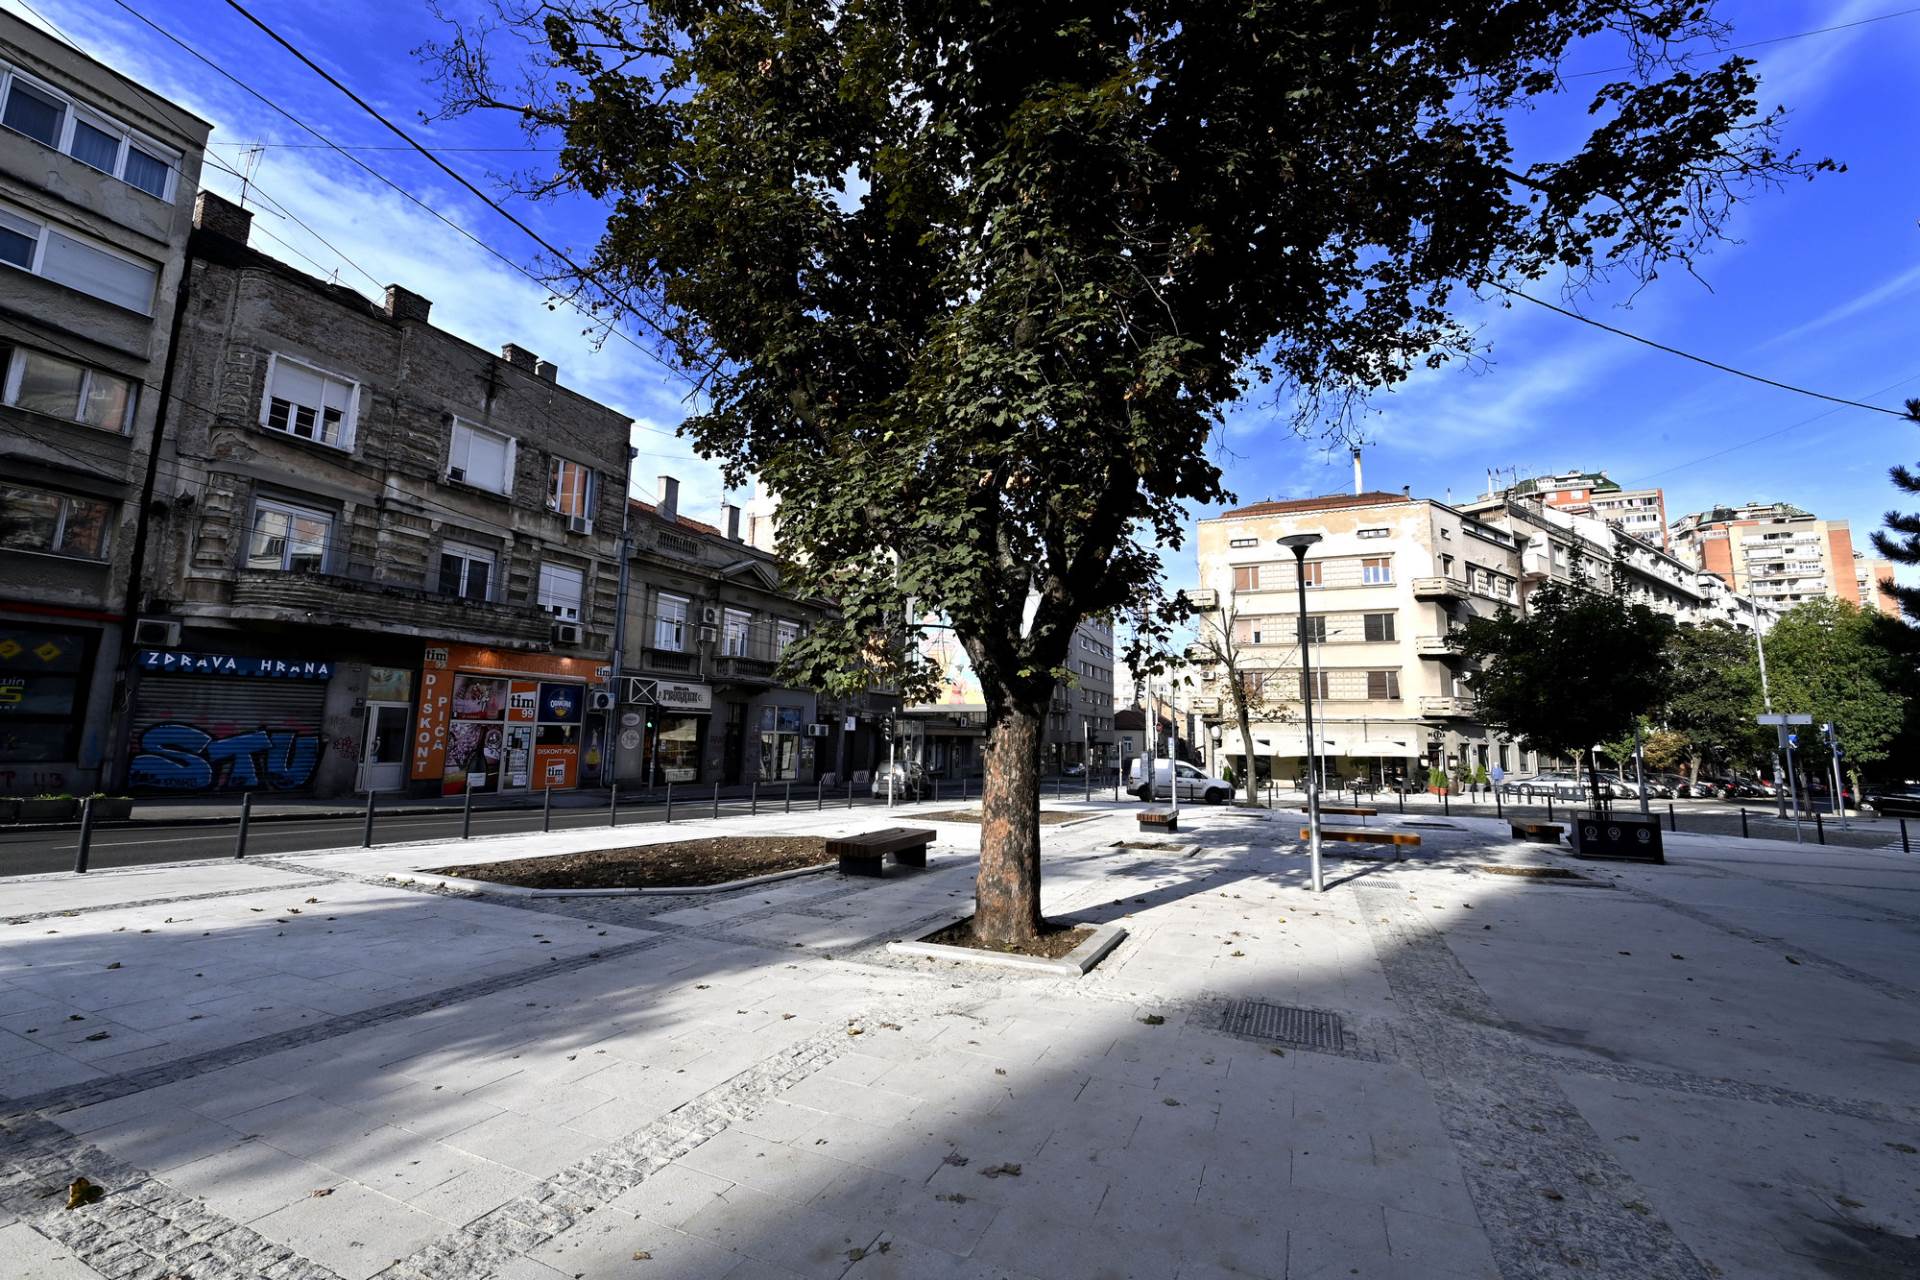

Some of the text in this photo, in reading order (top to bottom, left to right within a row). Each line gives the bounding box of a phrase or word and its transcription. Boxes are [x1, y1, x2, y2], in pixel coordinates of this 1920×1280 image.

[426, 649, 446, 660] tim
[148, 652, 328, 674] ZDRAVA HRANA
[511, 695, 534, 708] tim
[521, 709, 534, 719] 99
[416, 674, 436, 773] DISKONT
[548, 767, 563, 777] tim
